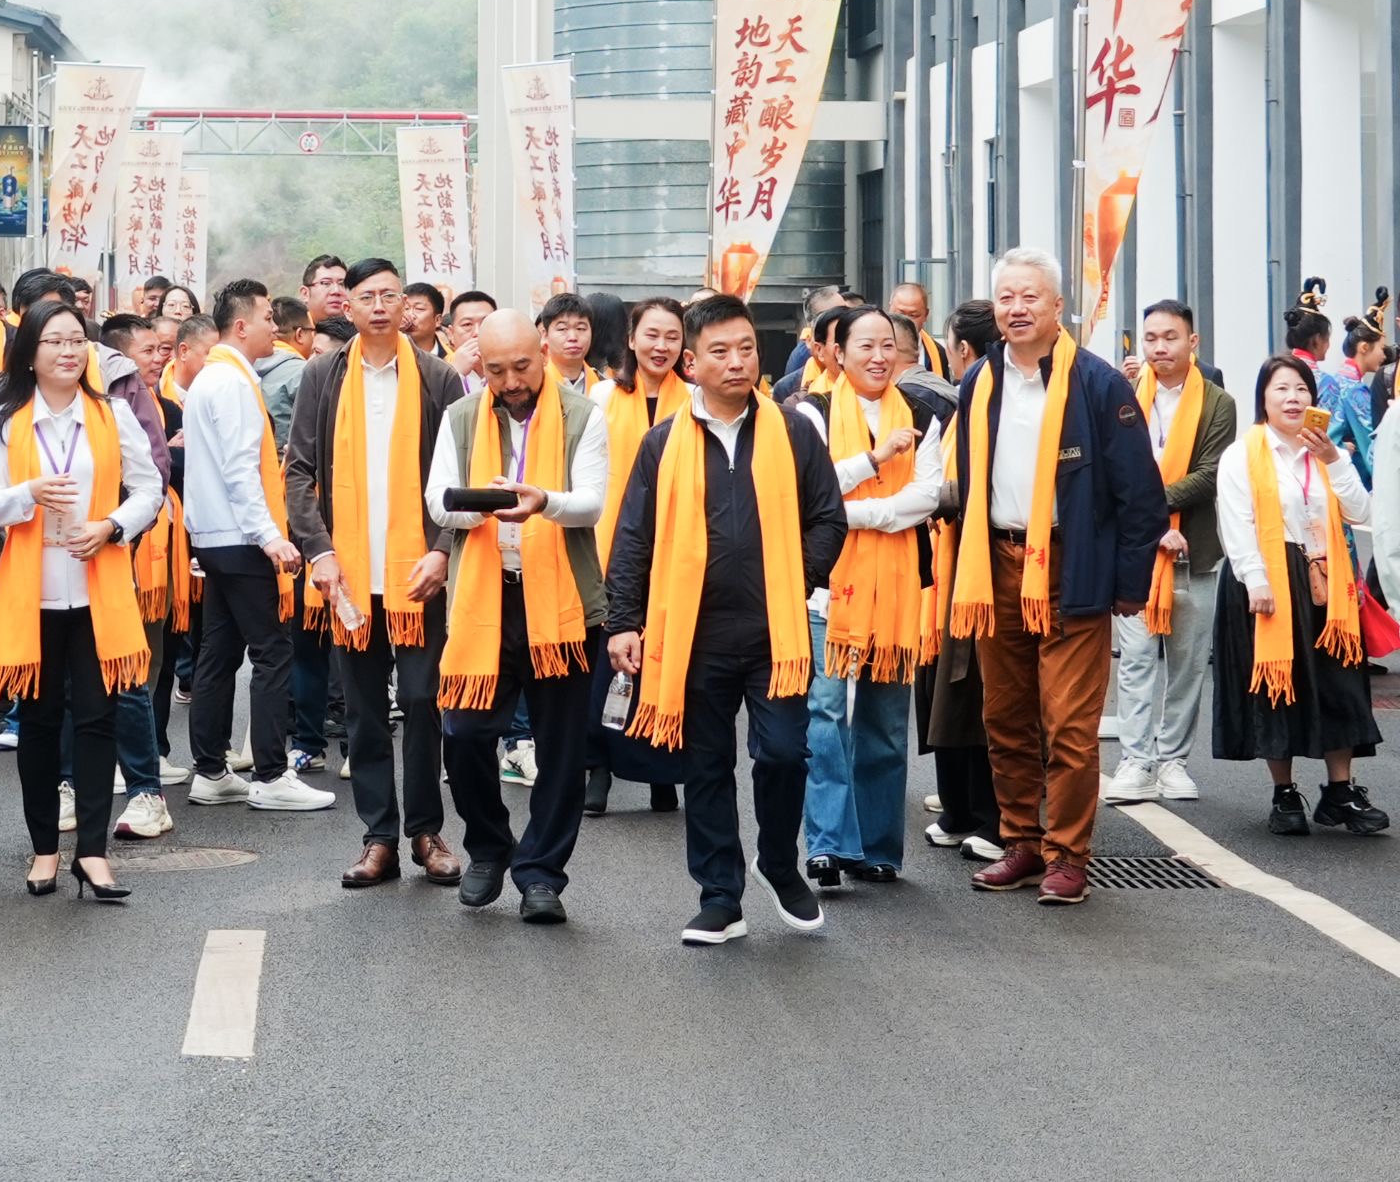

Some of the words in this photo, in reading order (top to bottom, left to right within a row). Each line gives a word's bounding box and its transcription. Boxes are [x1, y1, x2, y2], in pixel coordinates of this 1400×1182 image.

[715, 14, 770, 227] 地韵藏中华
[745, 15, 808, 221] 天工酿岁月
